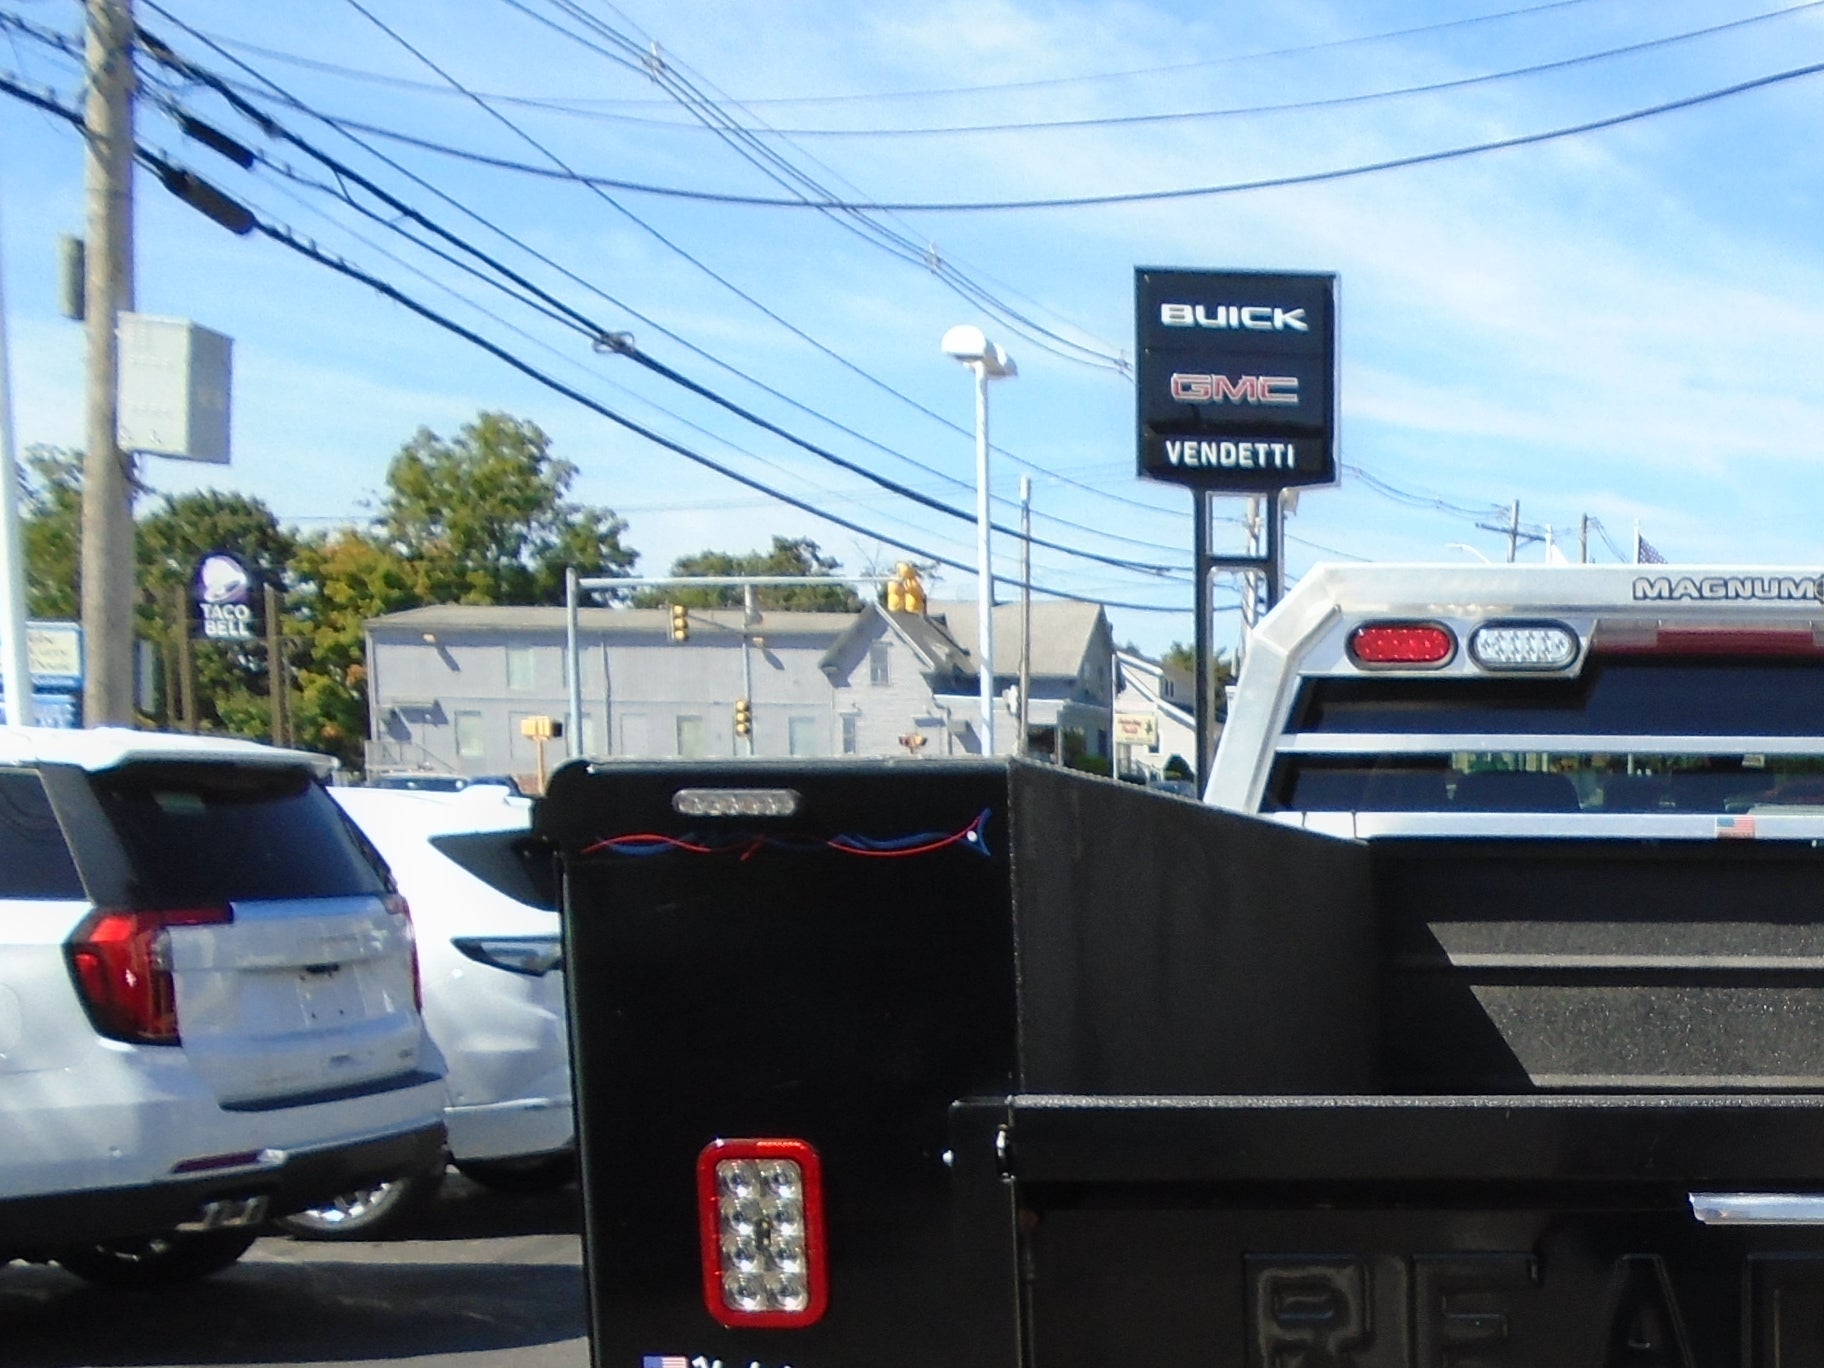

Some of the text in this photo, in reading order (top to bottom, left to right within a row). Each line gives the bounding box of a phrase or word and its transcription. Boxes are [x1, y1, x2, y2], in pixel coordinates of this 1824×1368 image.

[1160, 303, 1309, 331] BUICK
[1171, 373, 1299, 405] GMC
[1165, 440, 1295, 468] VENDETTI
[1633, 576, 1815, 600] MAGNUM
[200, 603, 251, 620] TACO
[204, 620, 250, 637] BELL
